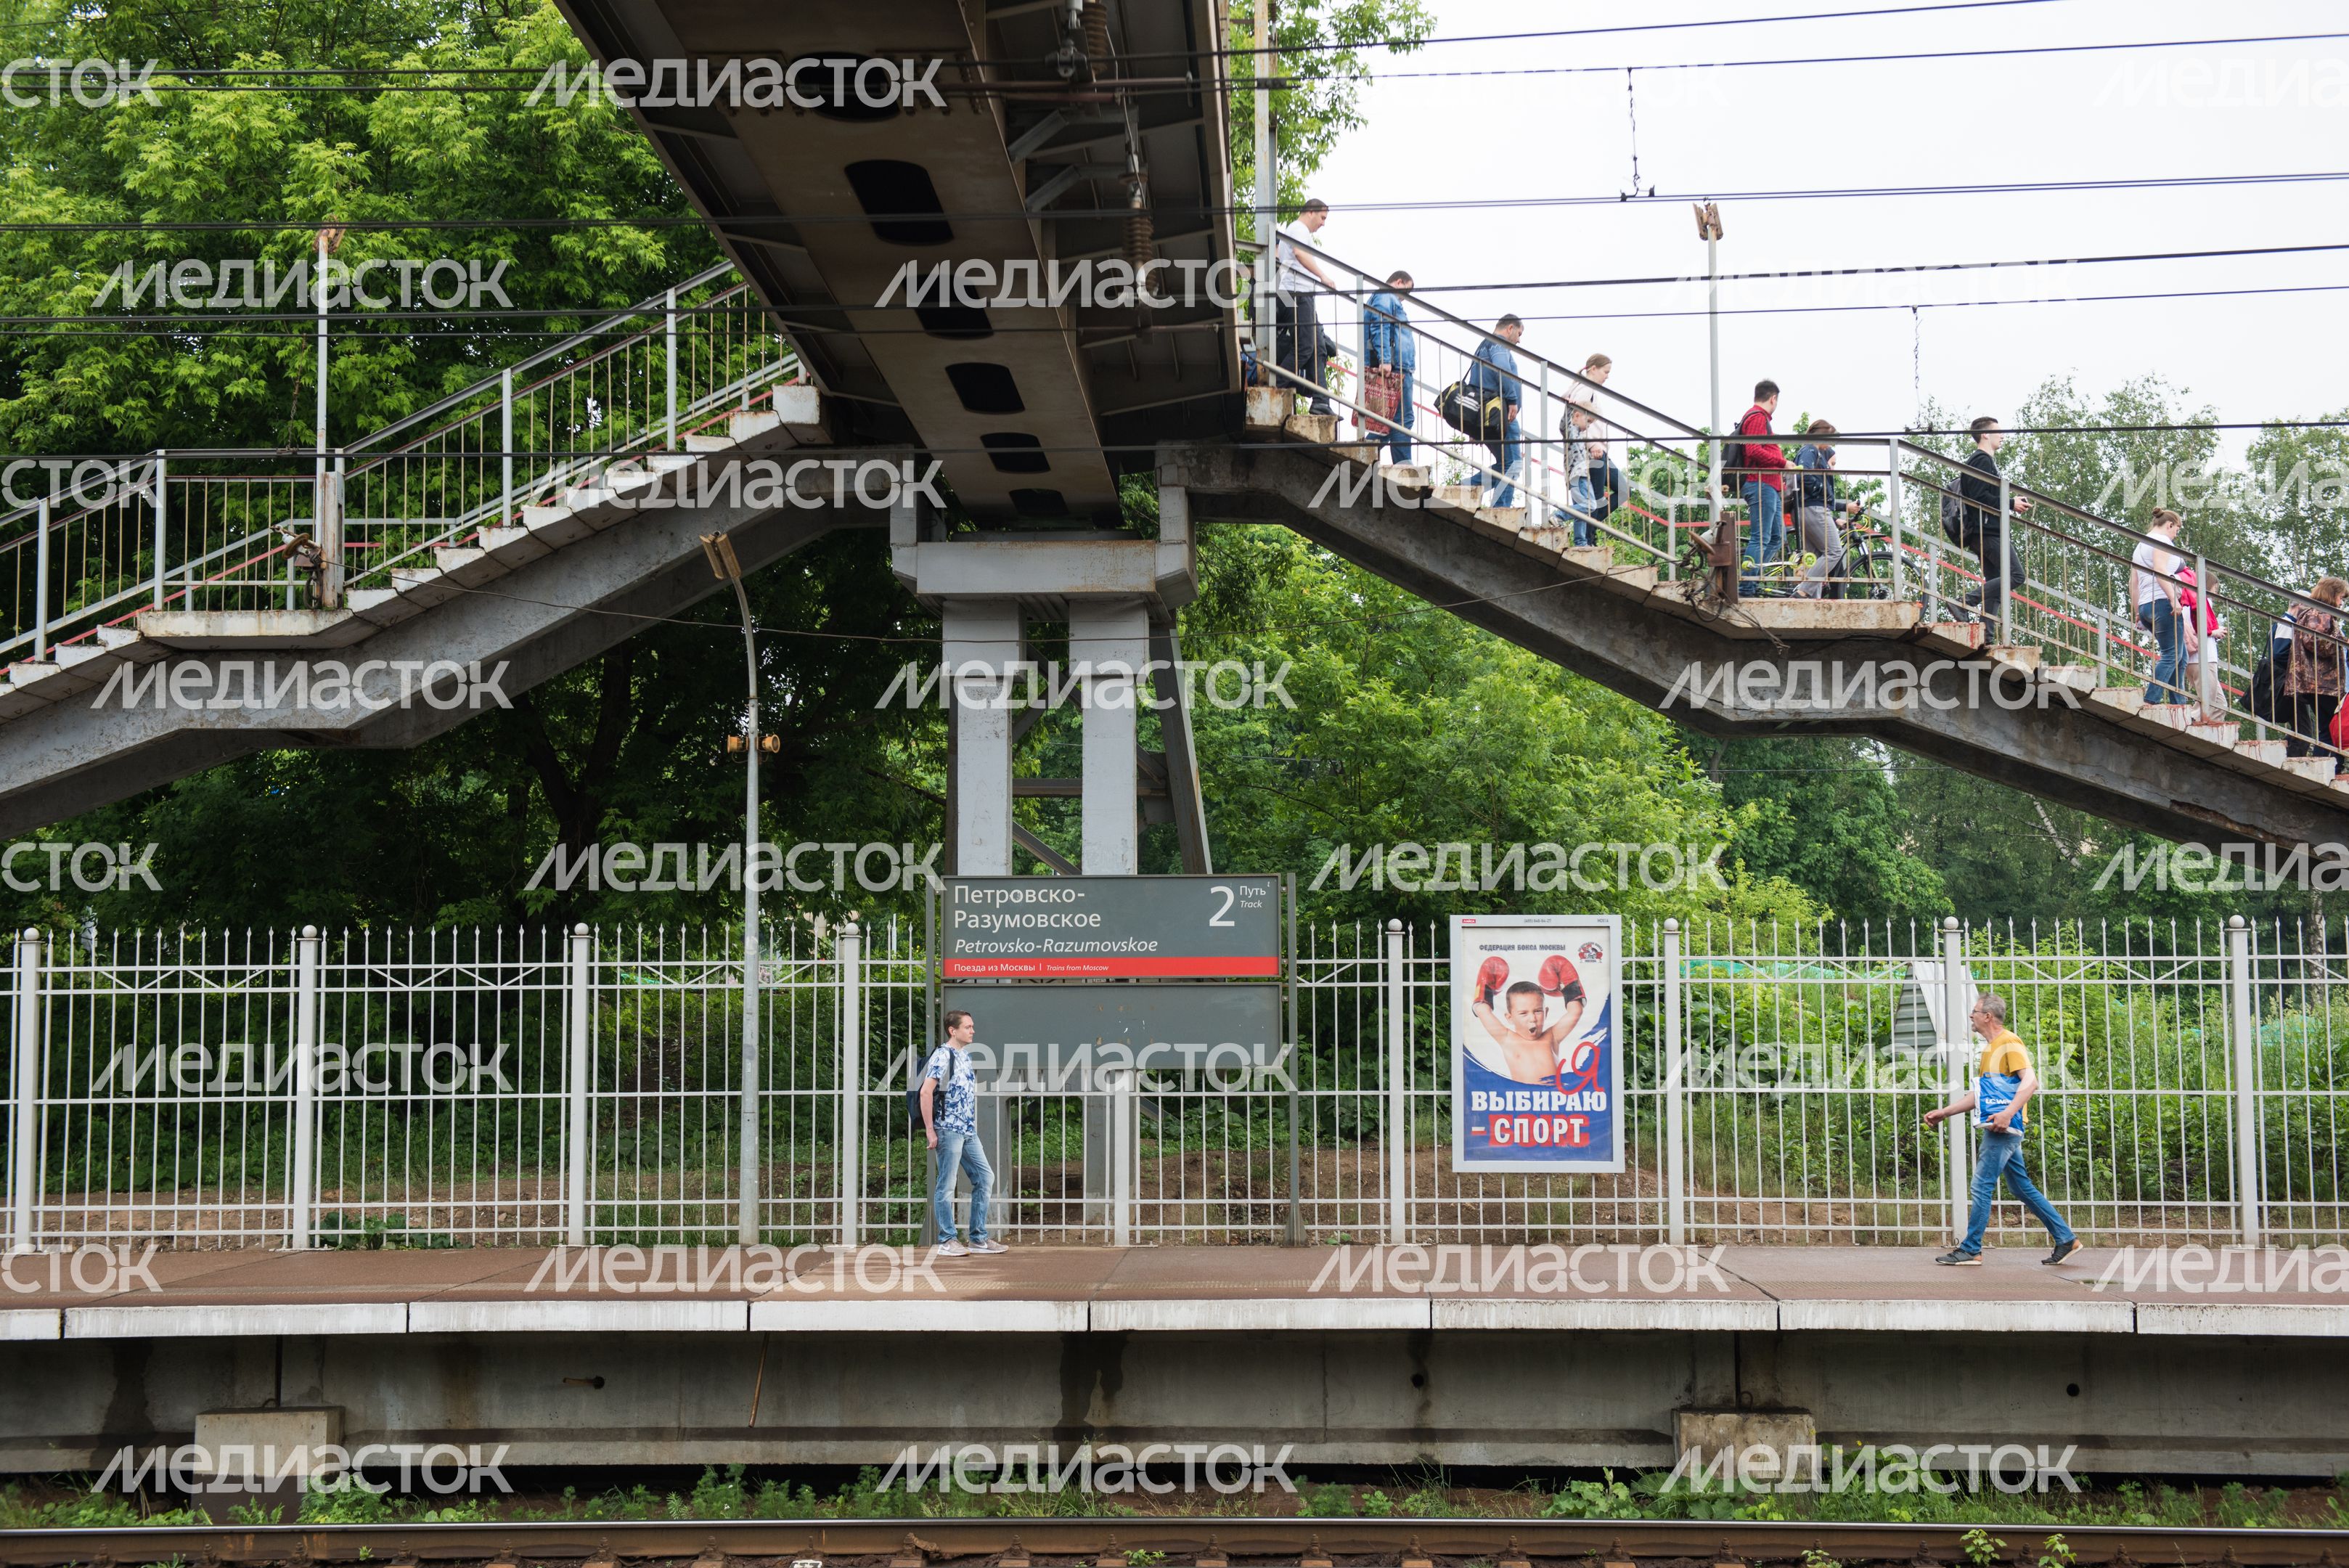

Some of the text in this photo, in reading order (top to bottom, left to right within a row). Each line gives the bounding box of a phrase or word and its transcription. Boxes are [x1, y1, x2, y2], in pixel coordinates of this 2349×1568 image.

[955, 885, 1085, 908] Петровско-
[1240, 886, 1266, 898] Путь
[1209, 886, 1235, 927] 2
[955, 910, 1101, 934] Разумовское
[955, 936, 1158, 953] Petrovsko-Razumovskoe
[954, 963, 986, 972] Поезда
[1556, 1041, 1605, 1095] Я
[1471, 1090, 1607, 1111] ВЫБИРАЮ
[1494, 1117, 1585, 1144] СПОРТ
